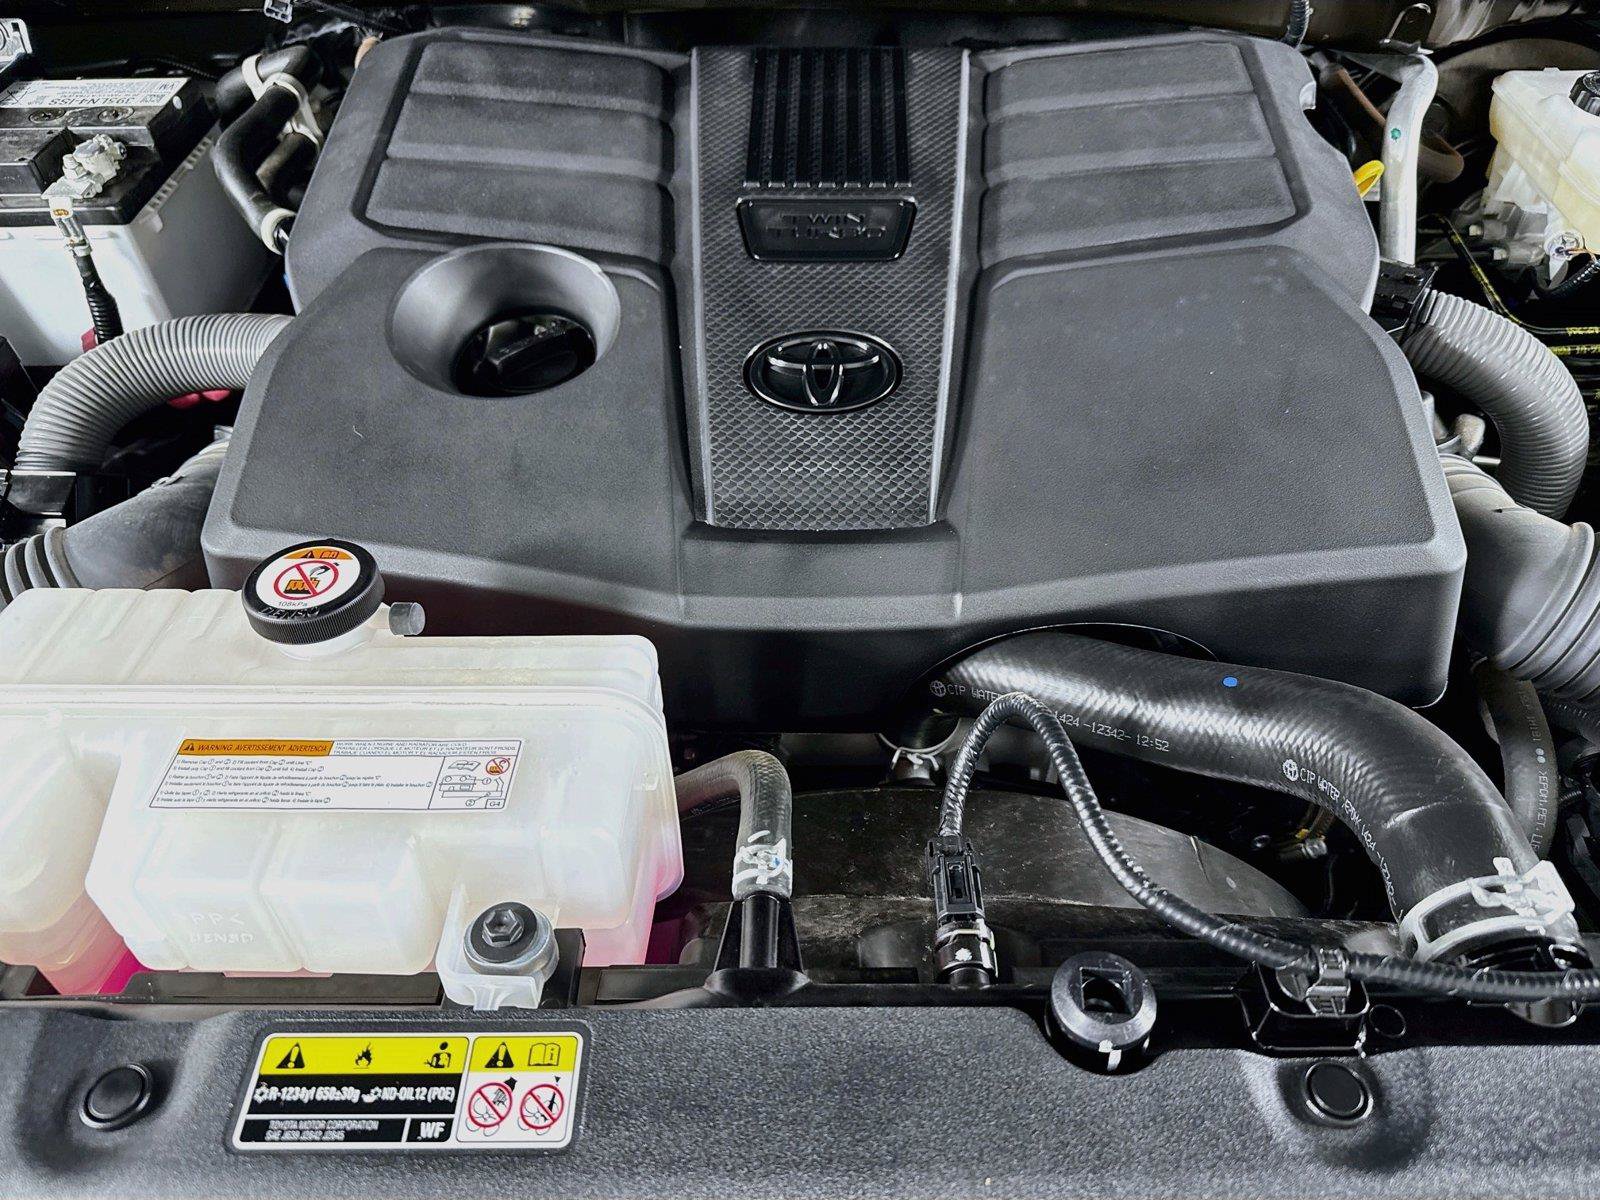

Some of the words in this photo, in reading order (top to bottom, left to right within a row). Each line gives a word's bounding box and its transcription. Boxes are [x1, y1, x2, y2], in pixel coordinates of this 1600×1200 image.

[779, 213, 866, 224] TWIN
[198, 744, 232, 752] WARNING
[235, 744, 285, 752] AVERTISSEMENT
[1300, 768, 1316, 784] CIP
[269, 1119, 298, 1131] TOYOTA
[298, 1119, 327, 1131] MOTOR
[326, 1119, 379, 1131] CORPORATION
